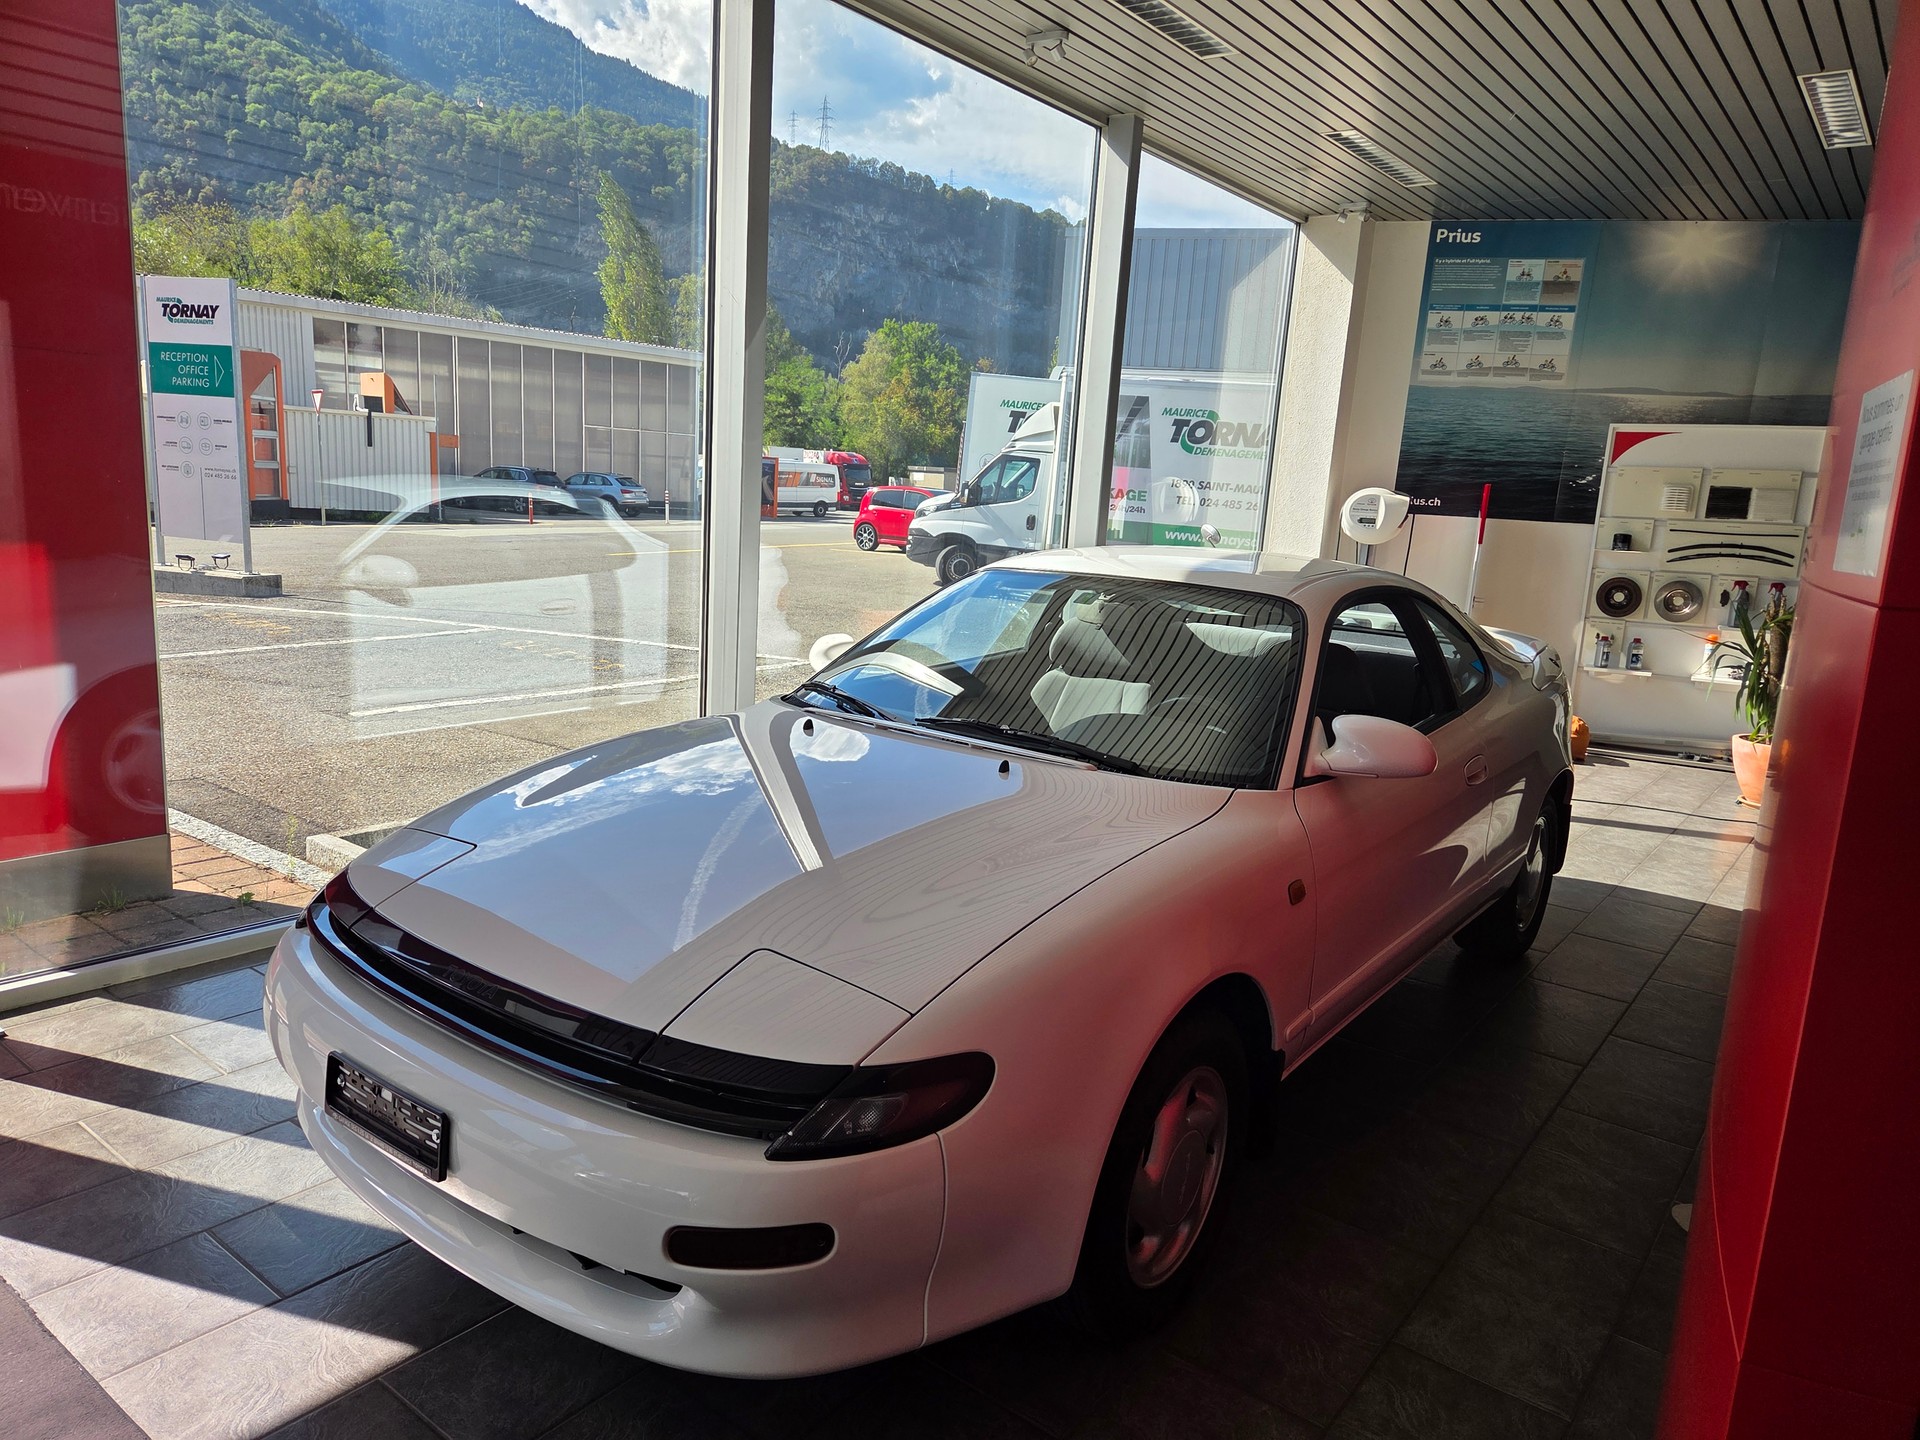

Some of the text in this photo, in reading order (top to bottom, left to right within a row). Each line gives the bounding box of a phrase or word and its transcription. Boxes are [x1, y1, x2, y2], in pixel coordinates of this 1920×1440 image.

[1436, 228, 1482, 243] Prius
[162, 303, 219, 319] TORNAY
[160, 351, 209, 362] RECEPTION
[178, 364, 209, 376] OFFICE
[172, 376, 210, 388] PARKING
[1000, 399, 1041, 411] MAURICE
[1162, 407, 1208, 418] MAURICE
[815, 475, 834, 483] SIGNAL
[1199, 497, 1219, 508] 024
[1222, 499, 1242, 510] 485
[442, 963, 499, 1000] TOYOTA
